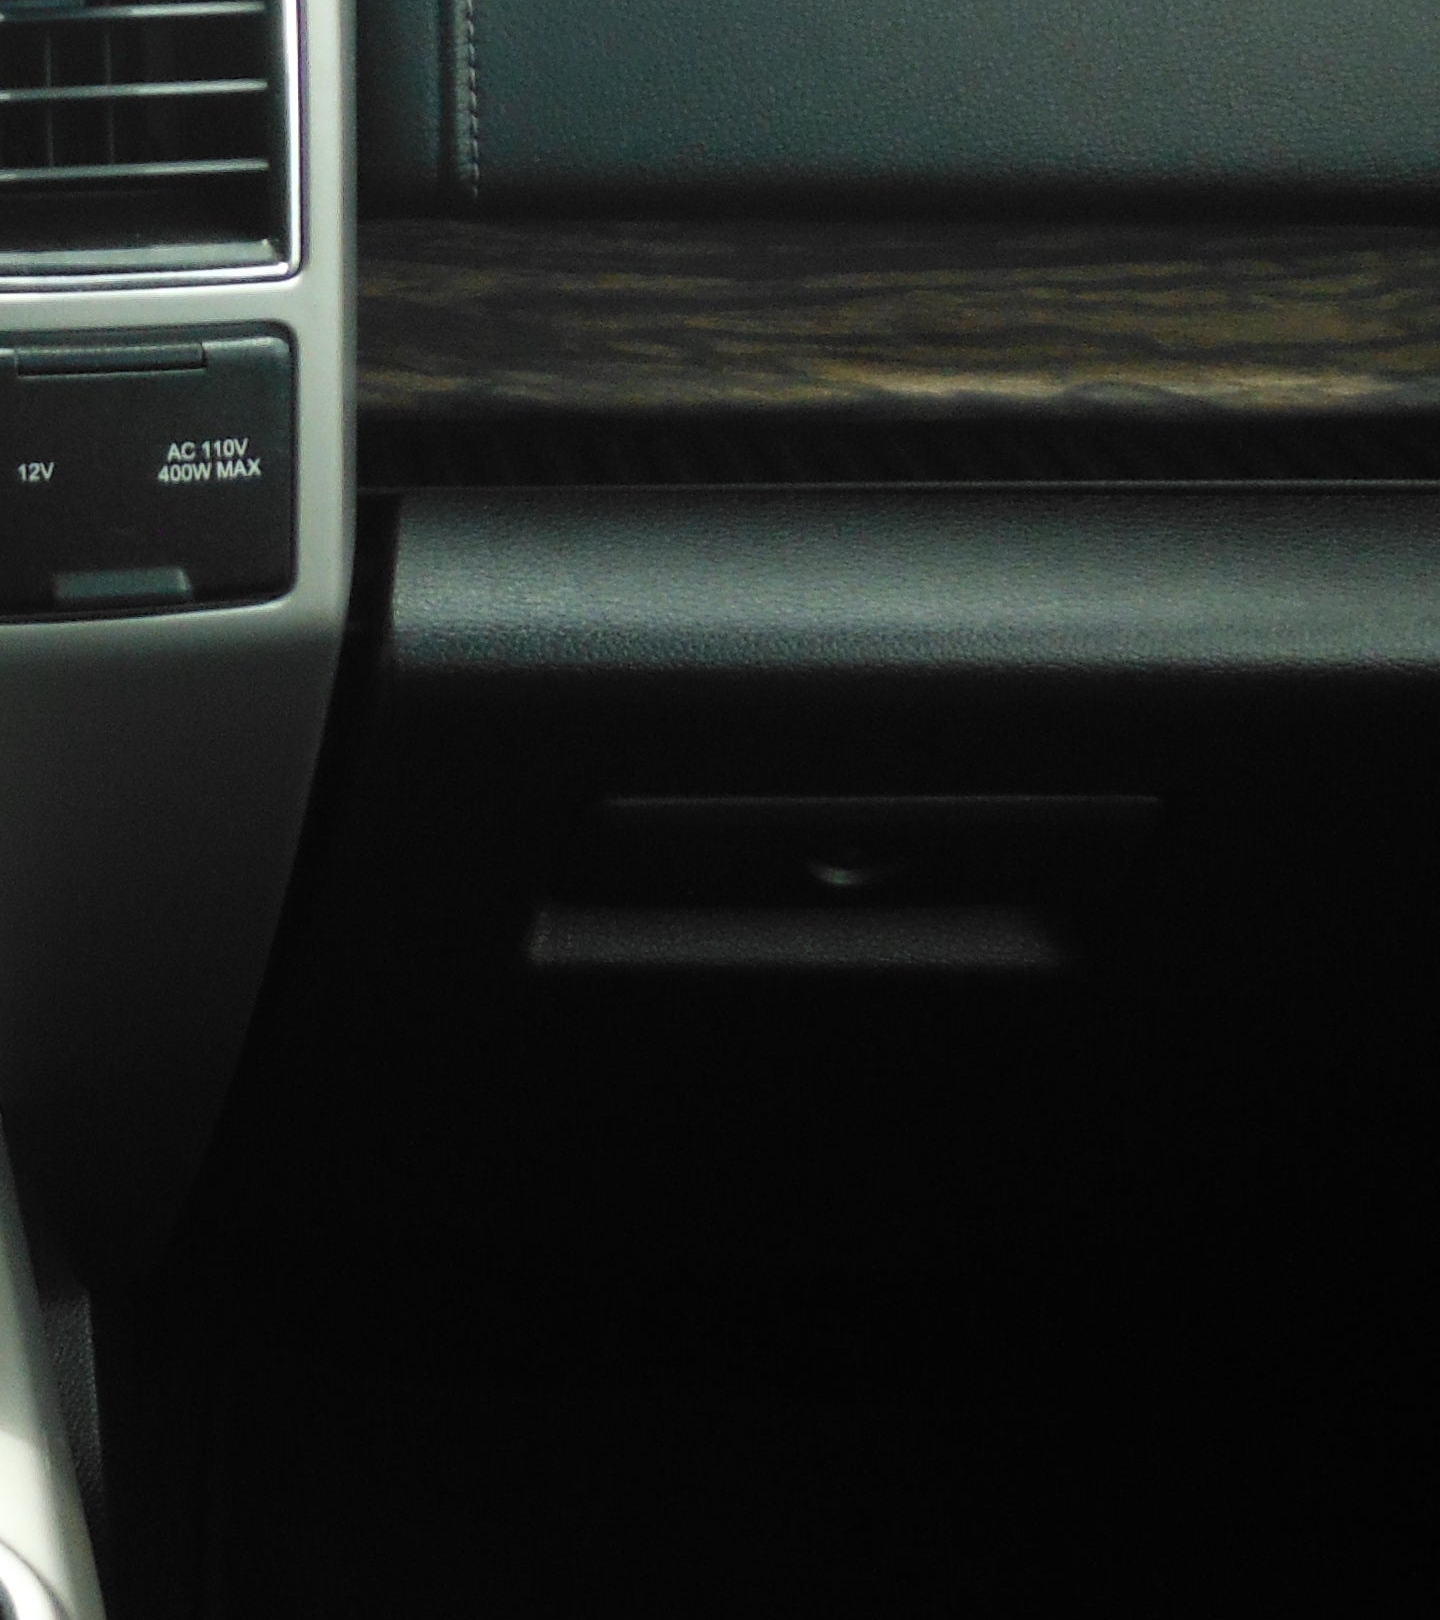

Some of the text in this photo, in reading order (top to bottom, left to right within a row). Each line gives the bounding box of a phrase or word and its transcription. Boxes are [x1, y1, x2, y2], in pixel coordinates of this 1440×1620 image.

[167, 437, 250, 461] AC 110V
[17, 461, 56, 481] 12V
[158, 458, 262, 483] 400W MAX
